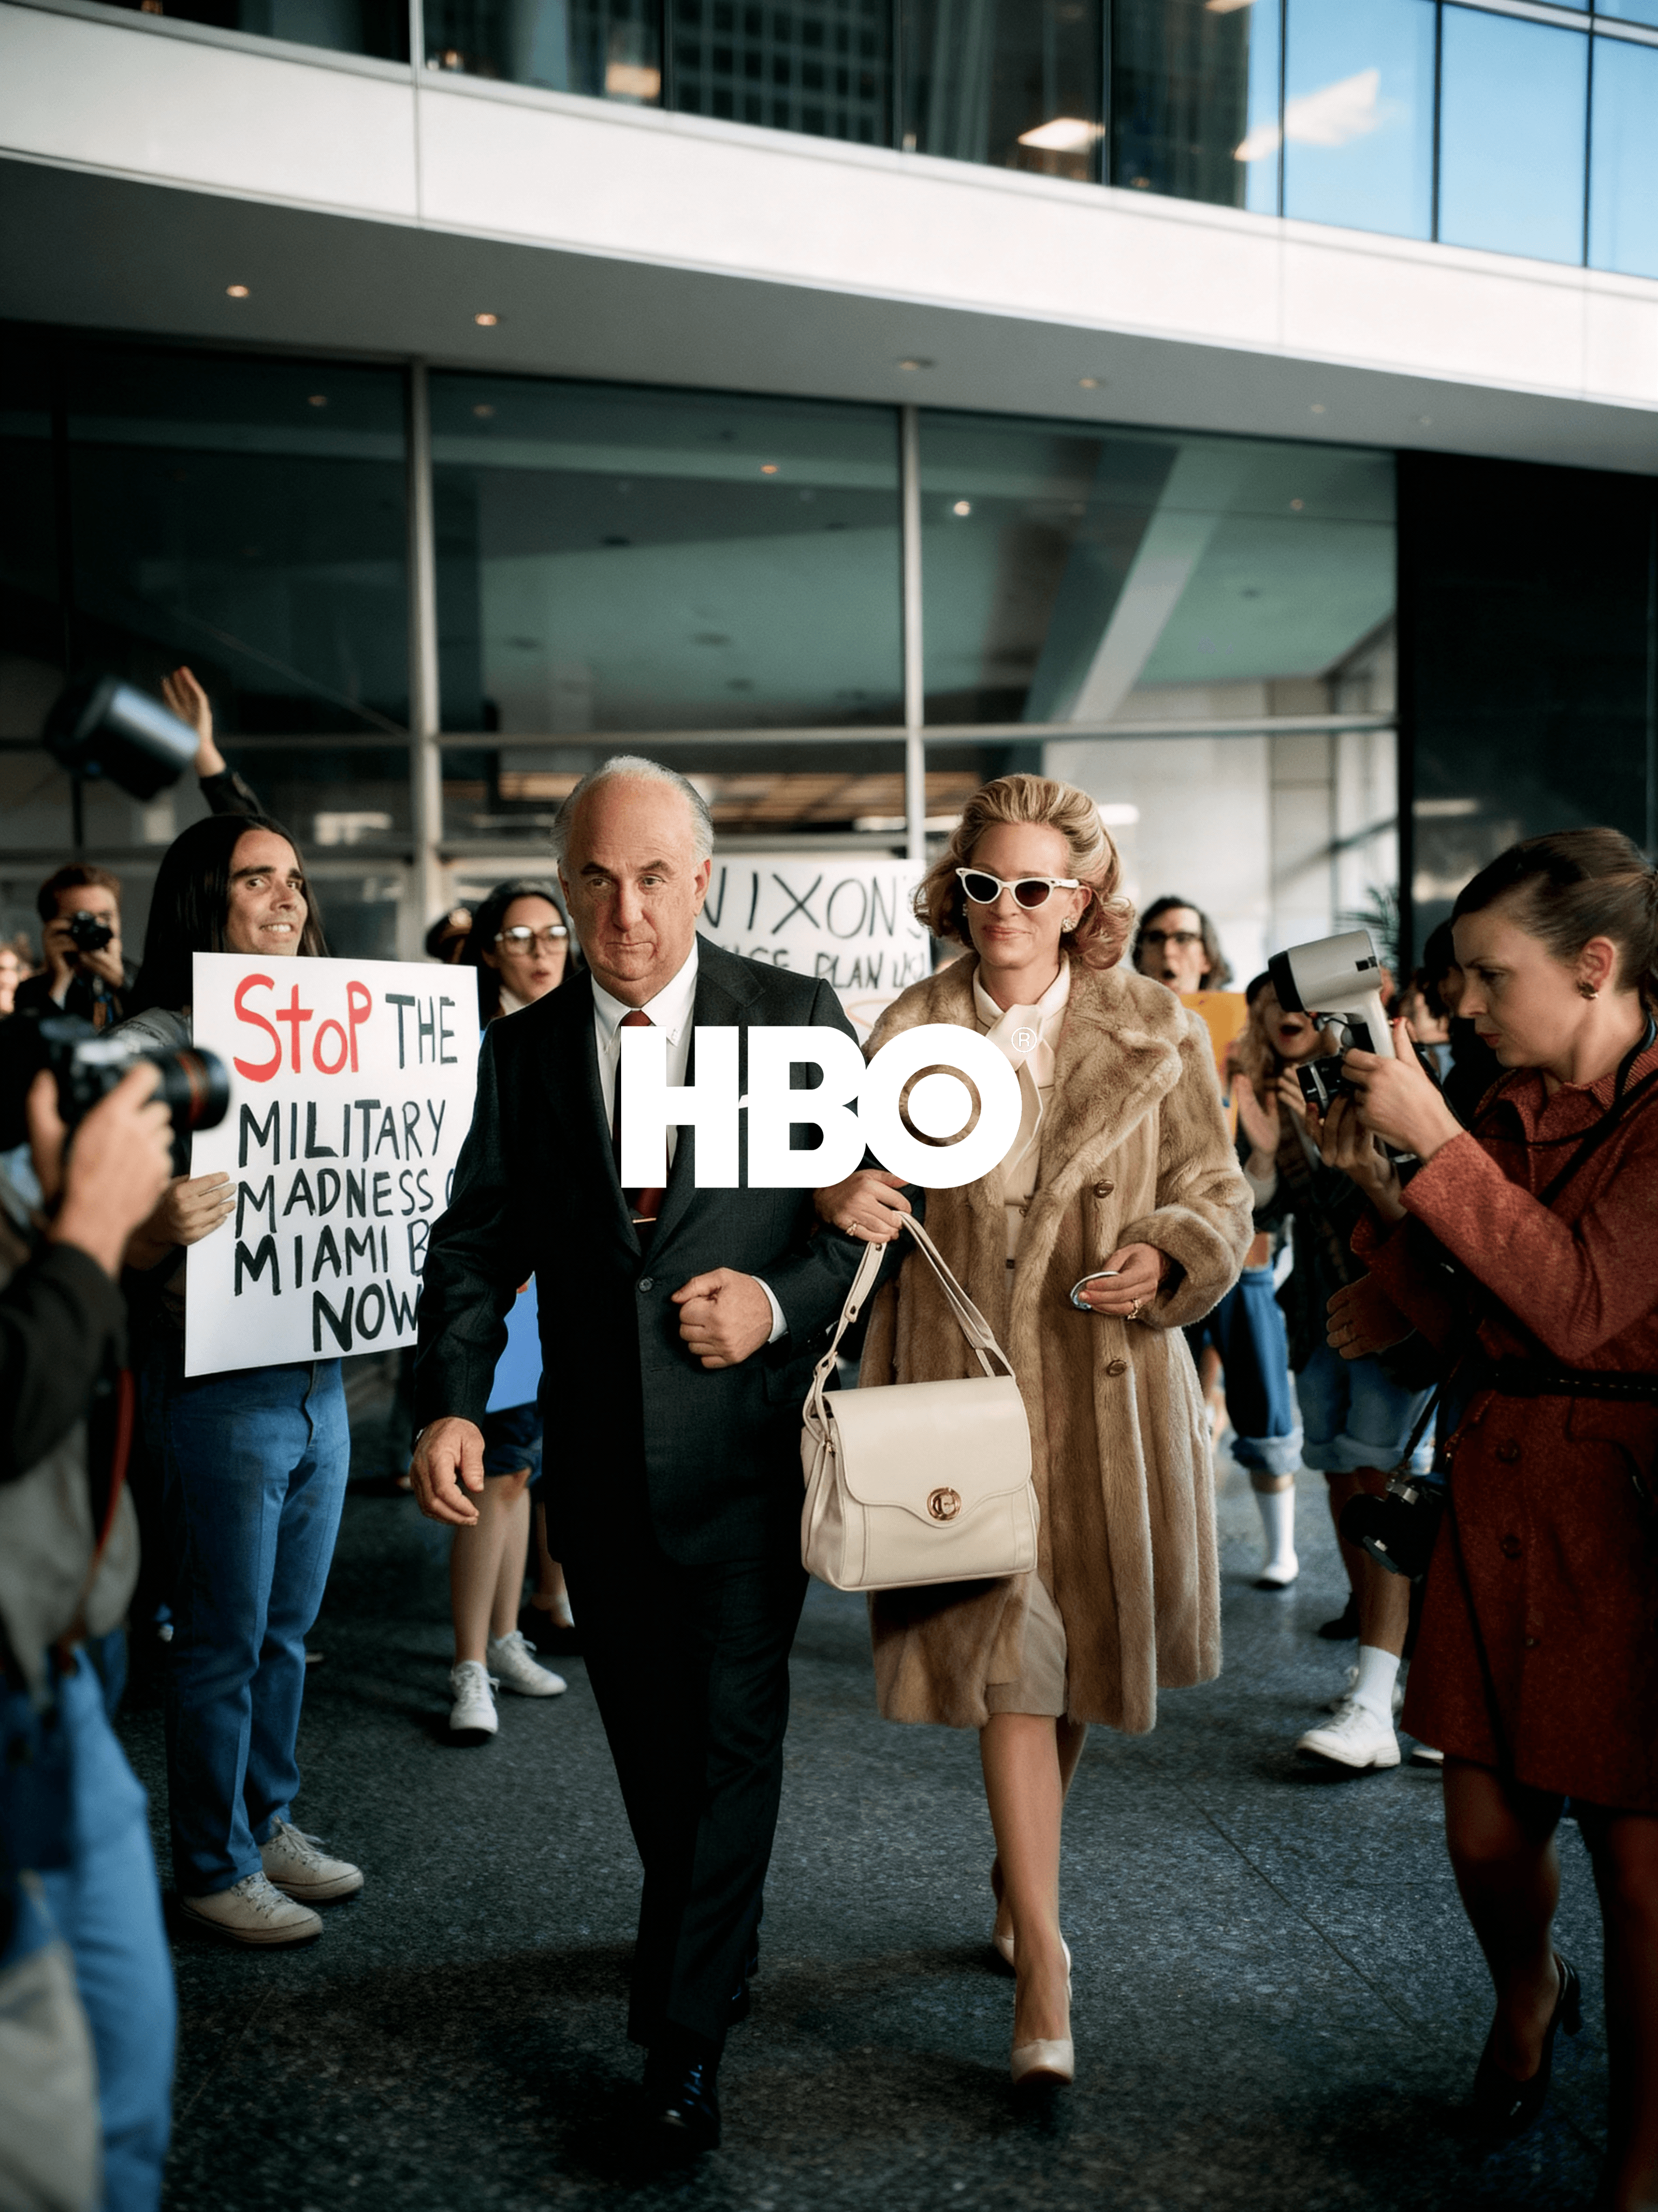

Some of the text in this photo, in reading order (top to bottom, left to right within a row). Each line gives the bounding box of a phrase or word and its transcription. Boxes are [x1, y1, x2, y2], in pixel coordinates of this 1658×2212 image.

[814, 952, 884, 989] PLAN
[386, 994, 457, 1069] THE
[239, 1100, 445, 1168] MILITARY
[235, 1168, 434, 1240] MADNESS
[234, 1225, 388, 1297] MIAMI
[312, 1278, 422, 1353] NOW
